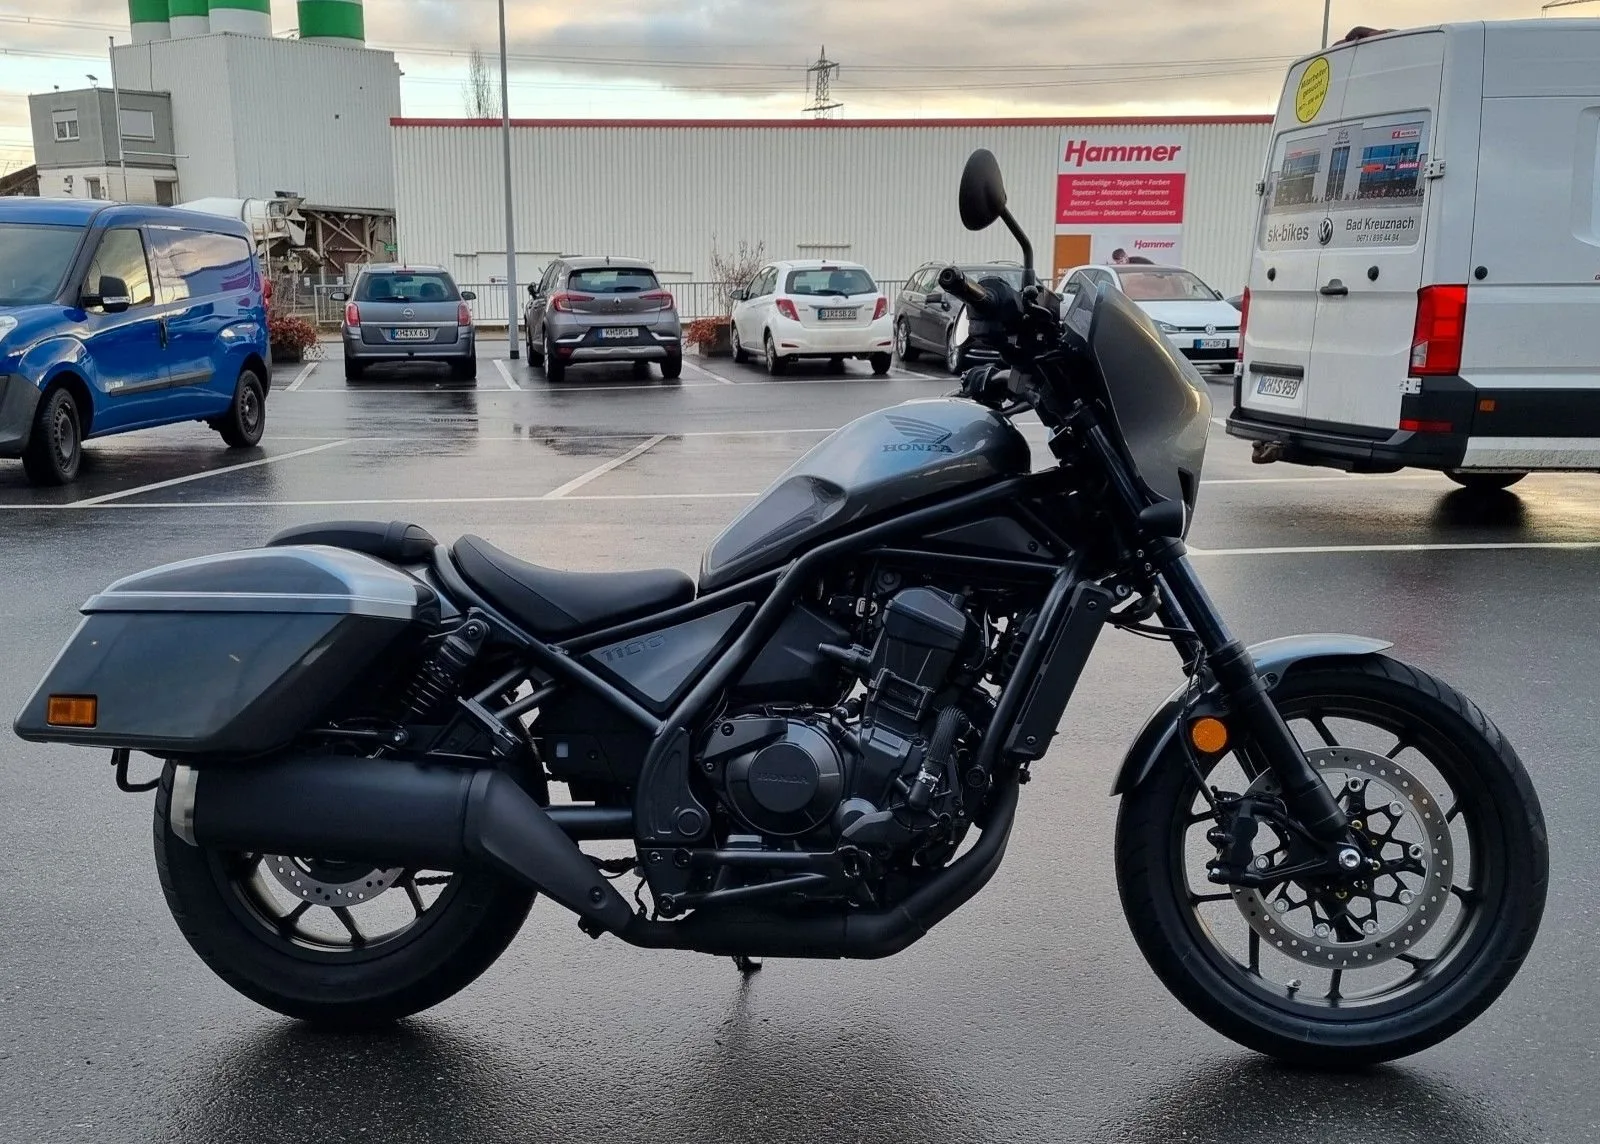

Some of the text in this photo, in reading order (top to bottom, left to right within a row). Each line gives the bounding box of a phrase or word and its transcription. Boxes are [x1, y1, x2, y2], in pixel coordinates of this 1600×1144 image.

[1064, 140, 1181, 167] Hammer
[1072, 189, 1096, 197] Tapeten
[1103, 209, 1137, 217] Dekoration
[1346, 216, 1414, 230] Bad Kreuznach
[1267, 224, 1309, 242] sk-bikes
[1134, 240, 1175, 249] Hammer
[882, 444, 954, 454] HONDA
